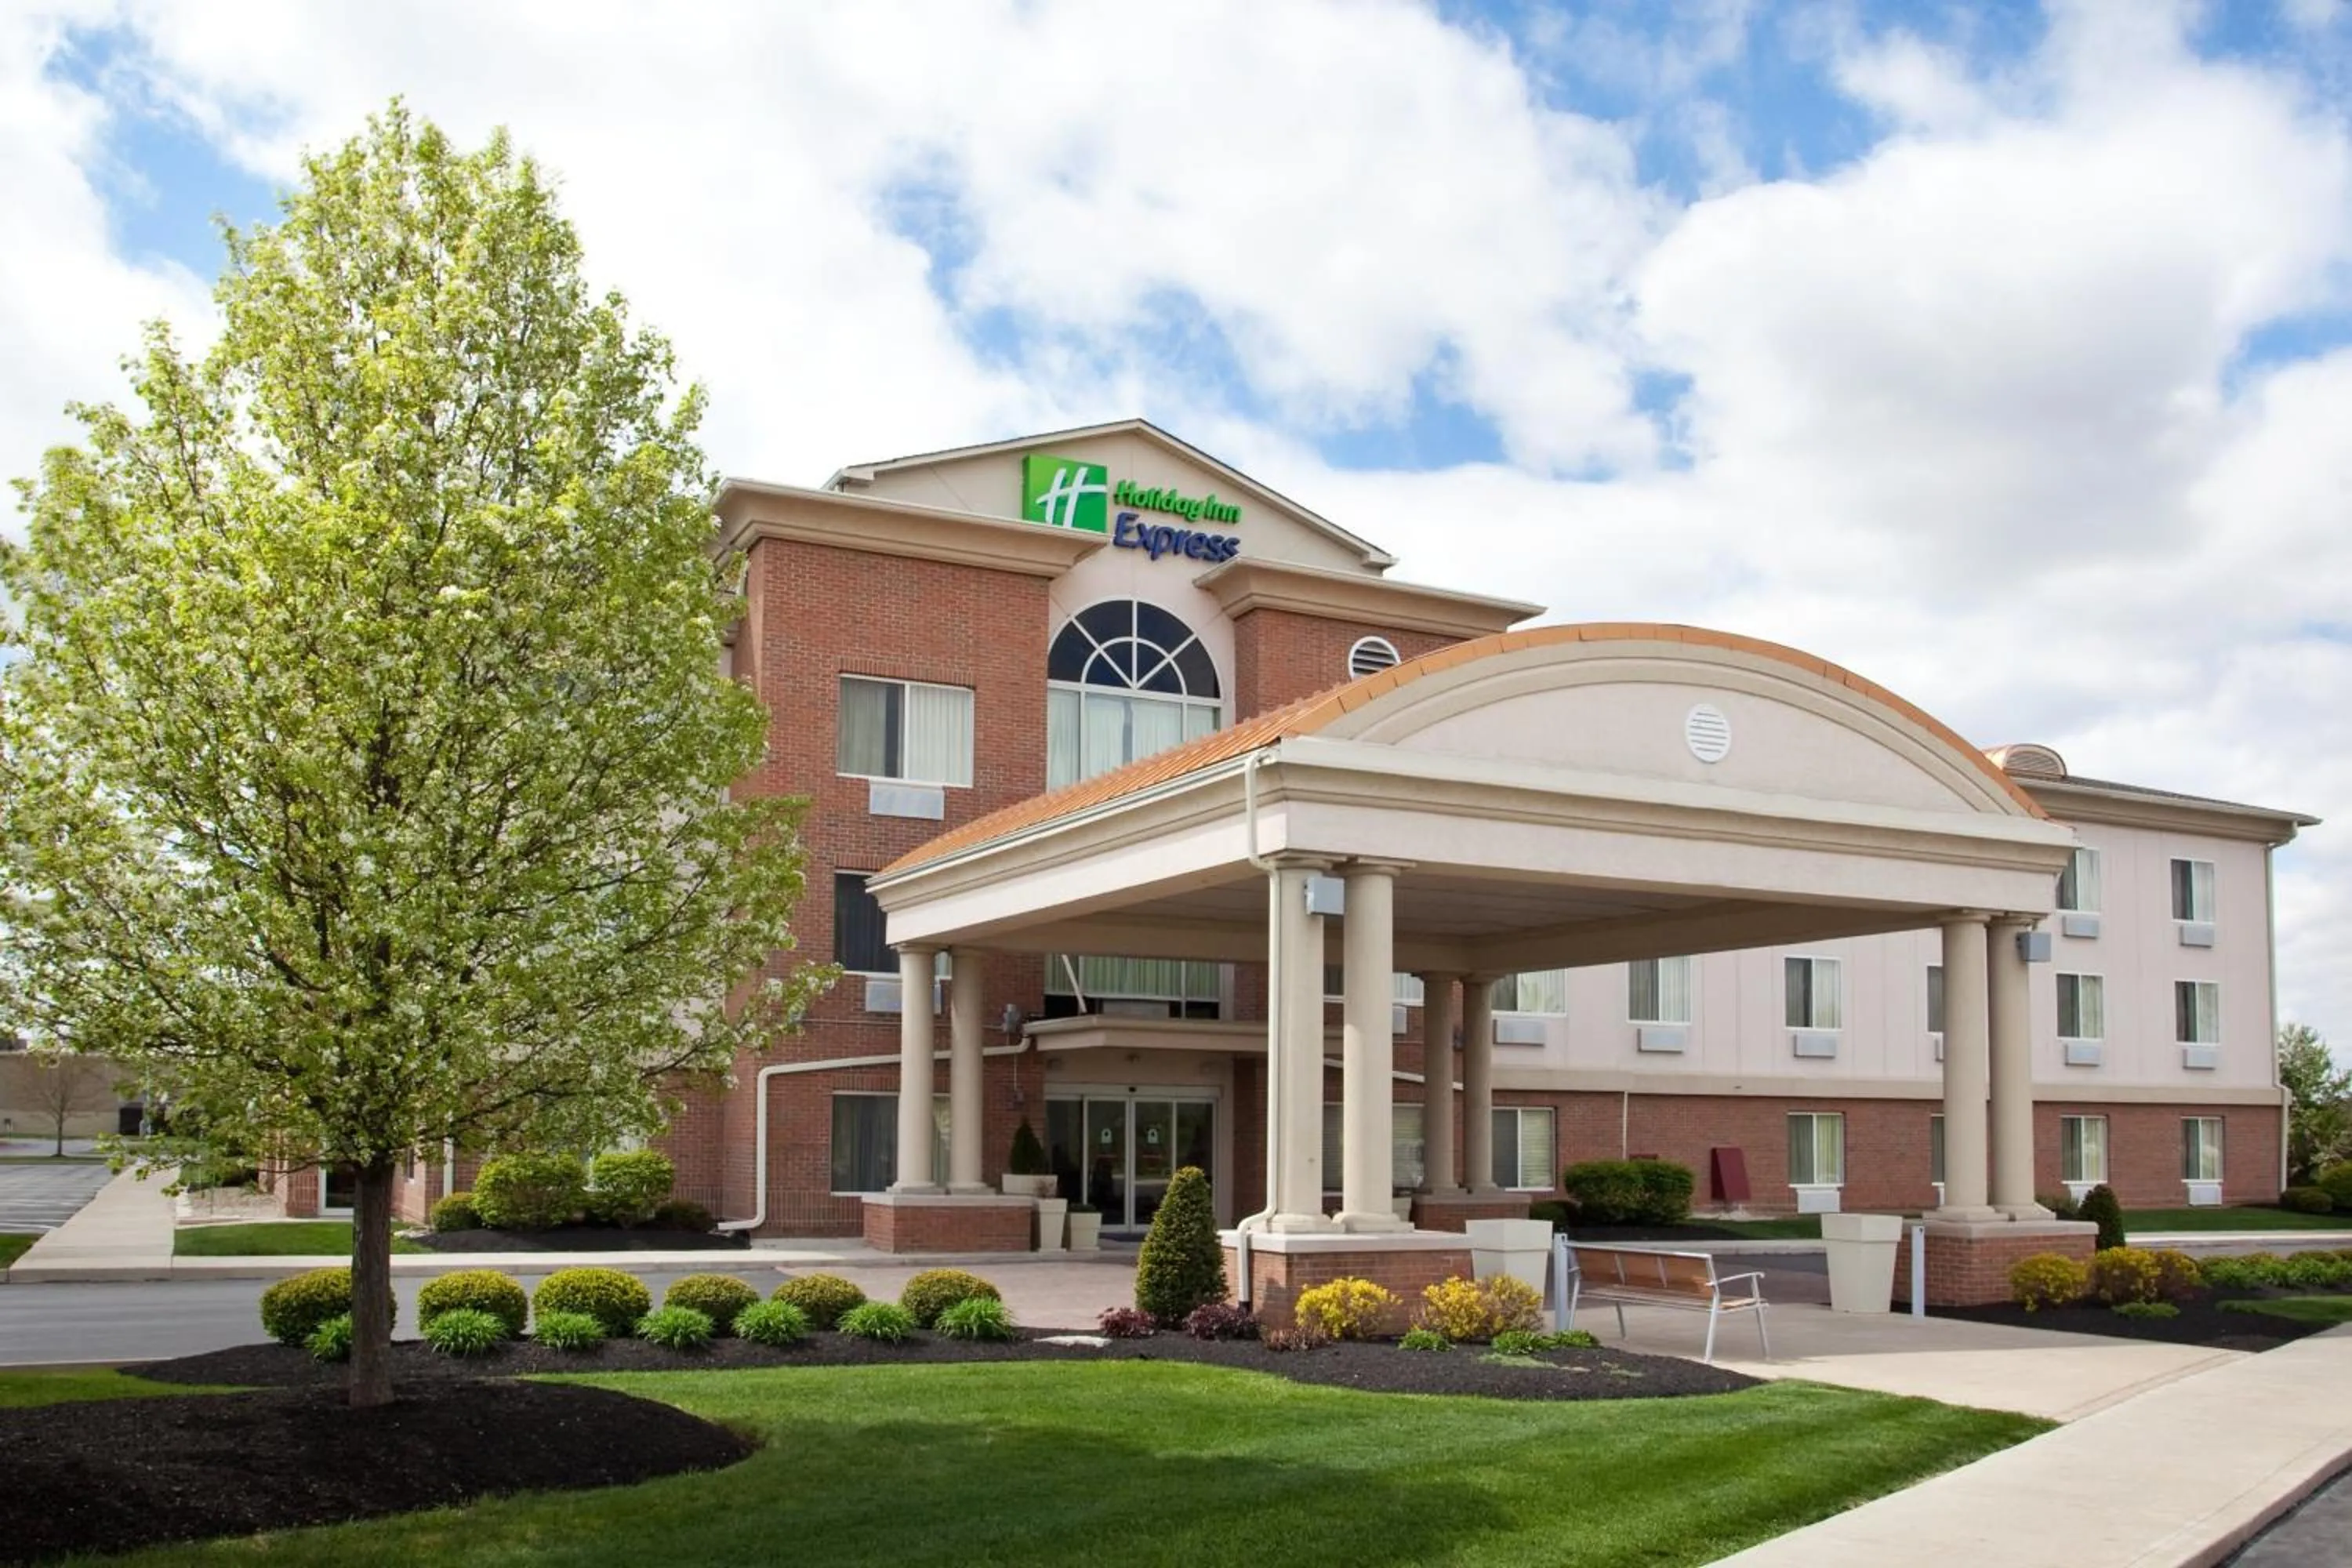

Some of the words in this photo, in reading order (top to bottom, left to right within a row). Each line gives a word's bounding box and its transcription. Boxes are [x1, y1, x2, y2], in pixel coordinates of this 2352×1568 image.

[1113, 479, 1203, 522] Holiday
[1202, 493, 1242, 524] Inn
[1112, 511, 1242, 561] Express
